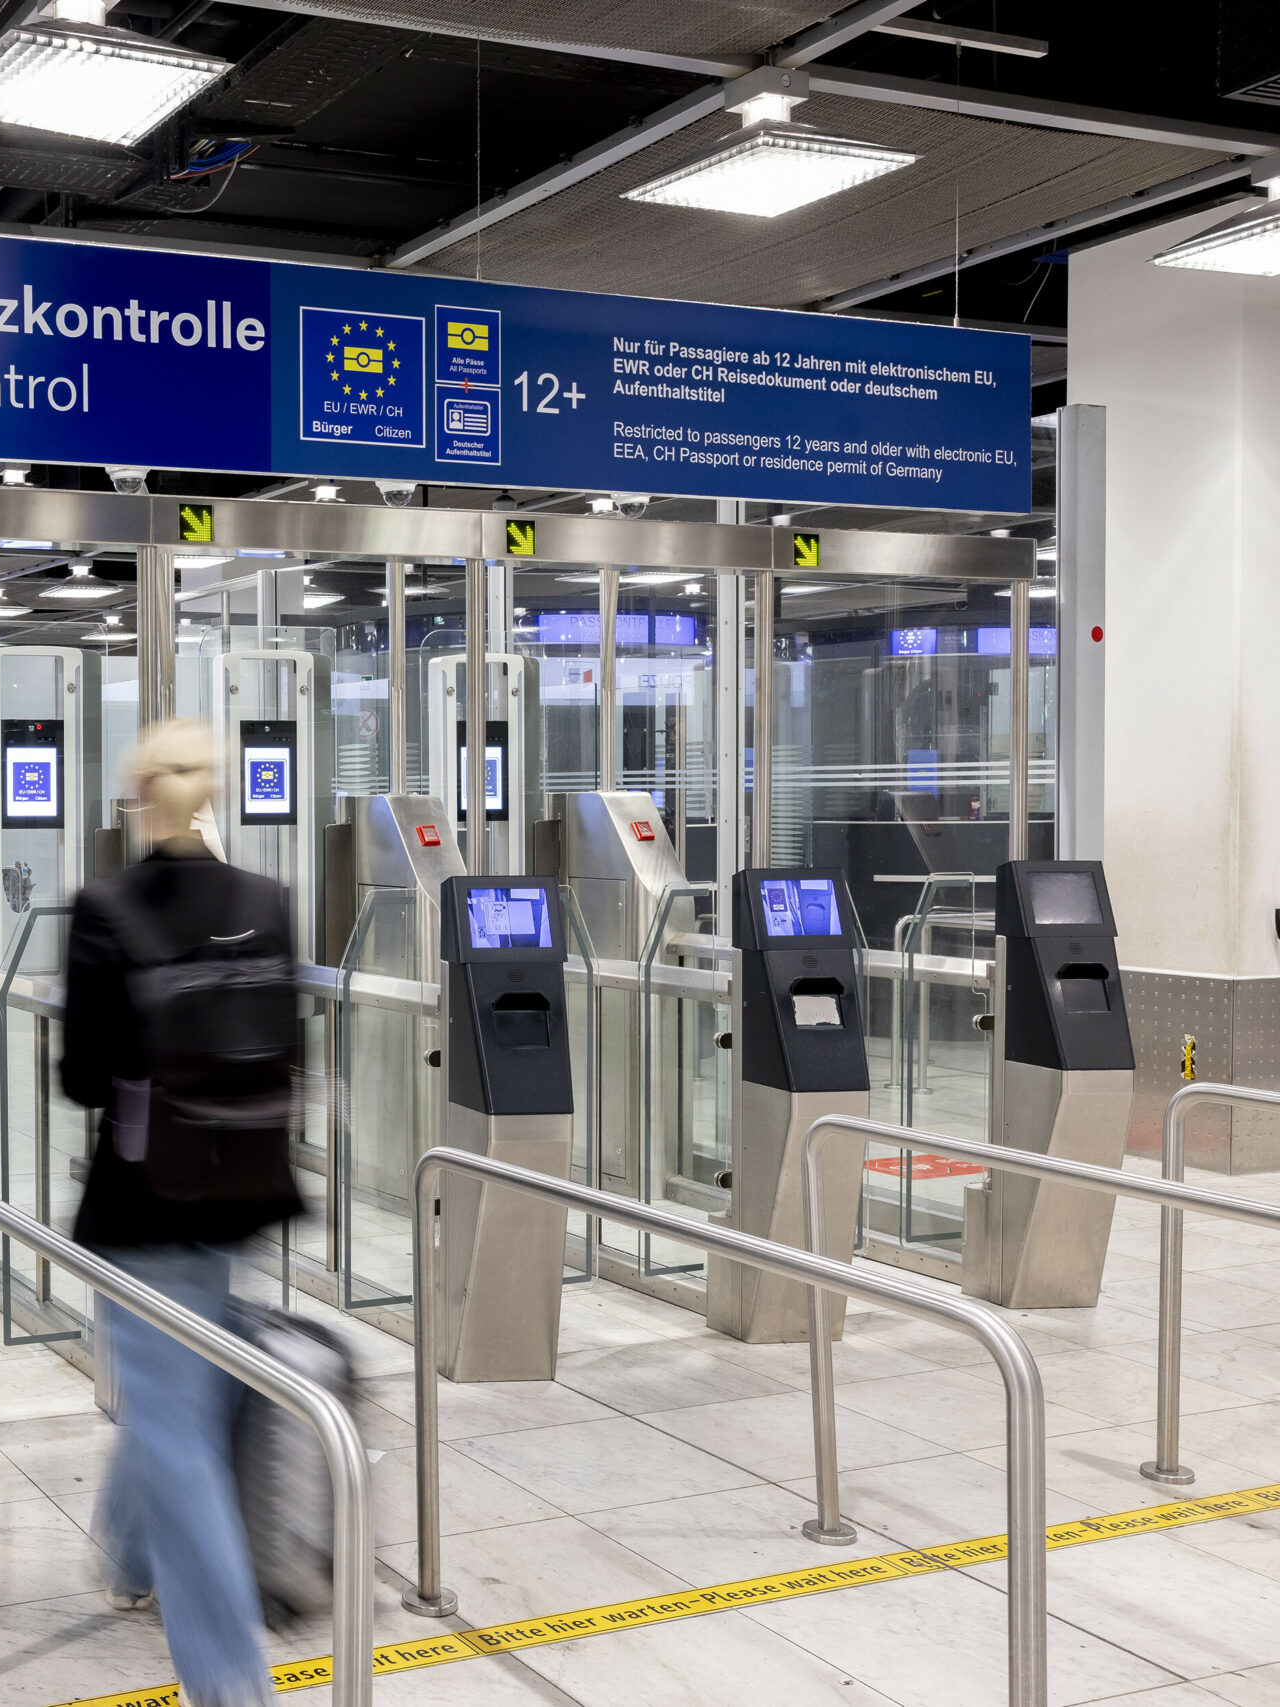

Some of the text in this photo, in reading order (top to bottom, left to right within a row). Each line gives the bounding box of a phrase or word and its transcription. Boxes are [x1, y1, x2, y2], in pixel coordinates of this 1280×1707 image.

[458, 366, 487, 375] Passports
[466, 358, 484, 366] Pässe
[614, 337, 996, 388] Nur für Passagiere ab 12 Jahren mit elektronischem EU,
[613, 379, 724, 403] Aufenthaltstitel
[614, 358, 938, 400] EWR oder CH Reisedokument oder deutschem
[513, 371, 586, 414] 12+
[324, 401, 340, 413] EU
[350, 404, 377, 415] EWR
[386, 406, 403, 417] CH
[313, 420, 411, 439] Bürger Citizen
[446, 448, 491, 457] Aufenthaltstitel
[453, 440, 484, 448] Deutscher
[614, 422, 1016, 467] Restricted to passengers 12 years and older with electronic EU,
[614, 443, 942, 483] EEA, CH Passport or residence permit of Germany
[959, 1544, 1004, 1558] hier
[1156, 1503, 1205, 1522] wait
[1200, 1498, 1249, 1513] here
[477, 1627, 547, 1646] Bitte
[544, 1617, 596, 1633] hier
[779, 1573, 836, 1590] wait
[831, 1565, 888, 1580] here
[395, 1643, 458, 1662] here
